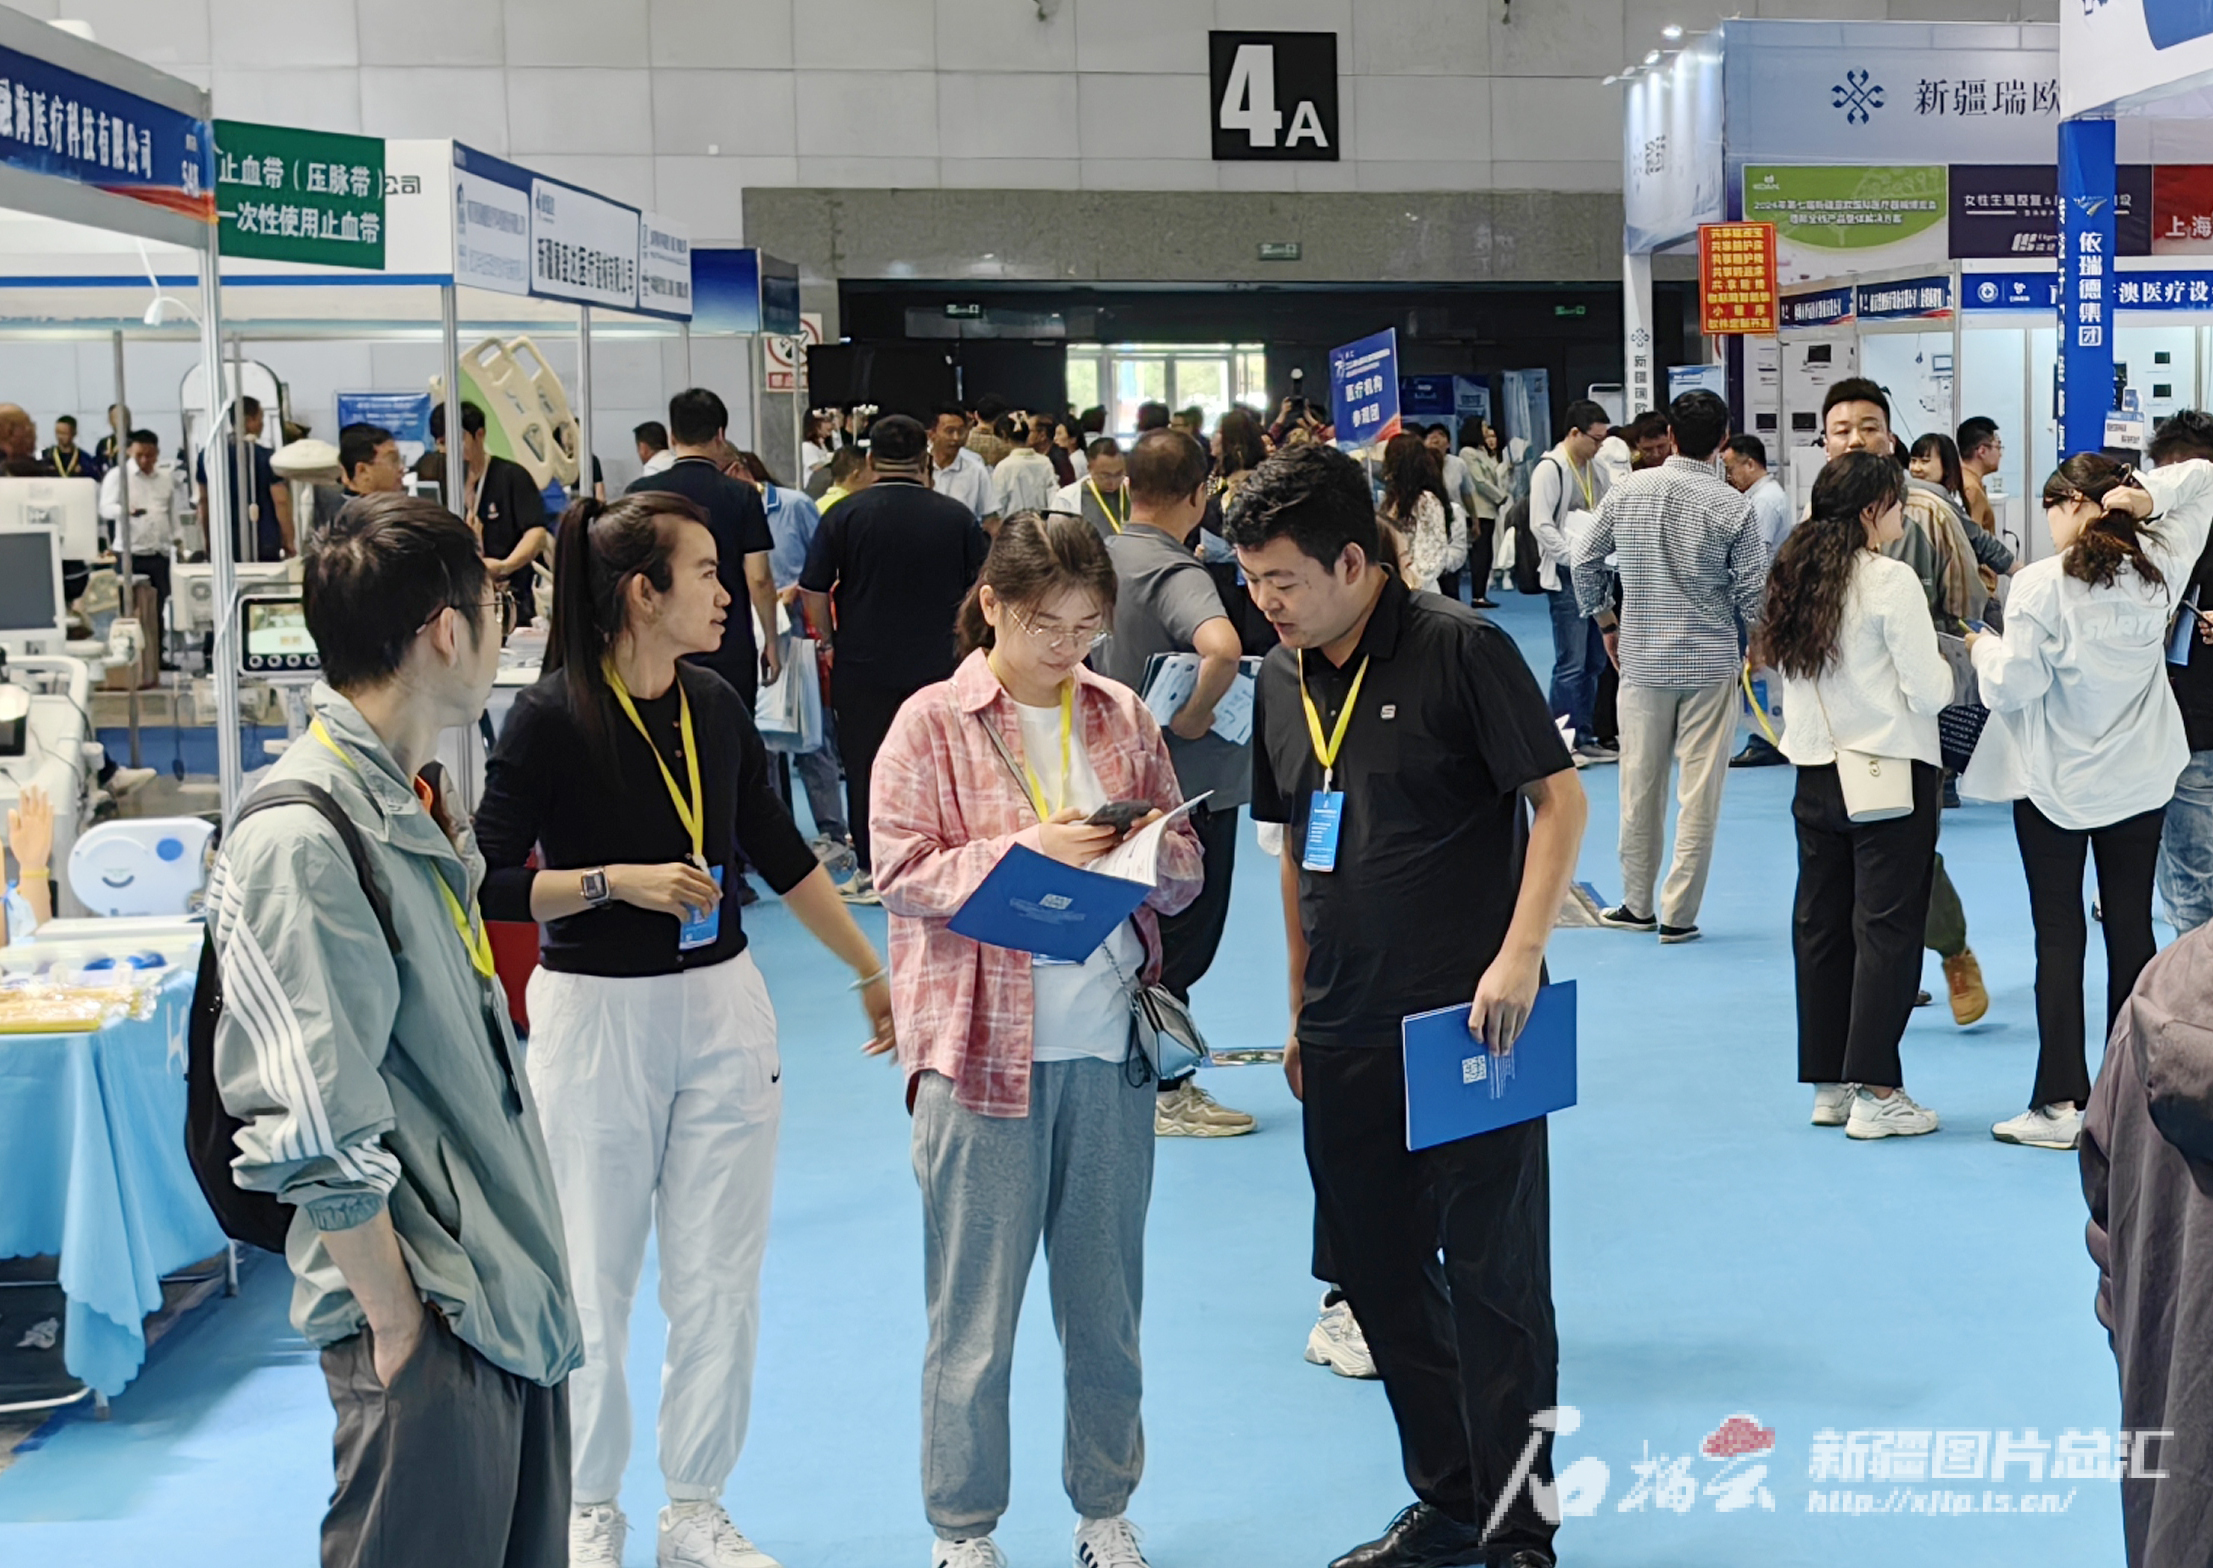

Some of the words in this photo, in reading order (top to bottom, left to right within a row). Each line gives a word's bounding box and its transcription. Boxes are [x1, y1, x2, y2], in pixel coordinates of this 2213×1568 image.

[1219, 44, 1330, 147] 4A
[1914, 79, 2060, 116] 新疆瑞欧
[218, 201, 381, 244] 一次性使用止血带
[2078, 232, 2102, 347] 依瑞德集团
[2112, 280, 2213, 304] 澳医疗设
